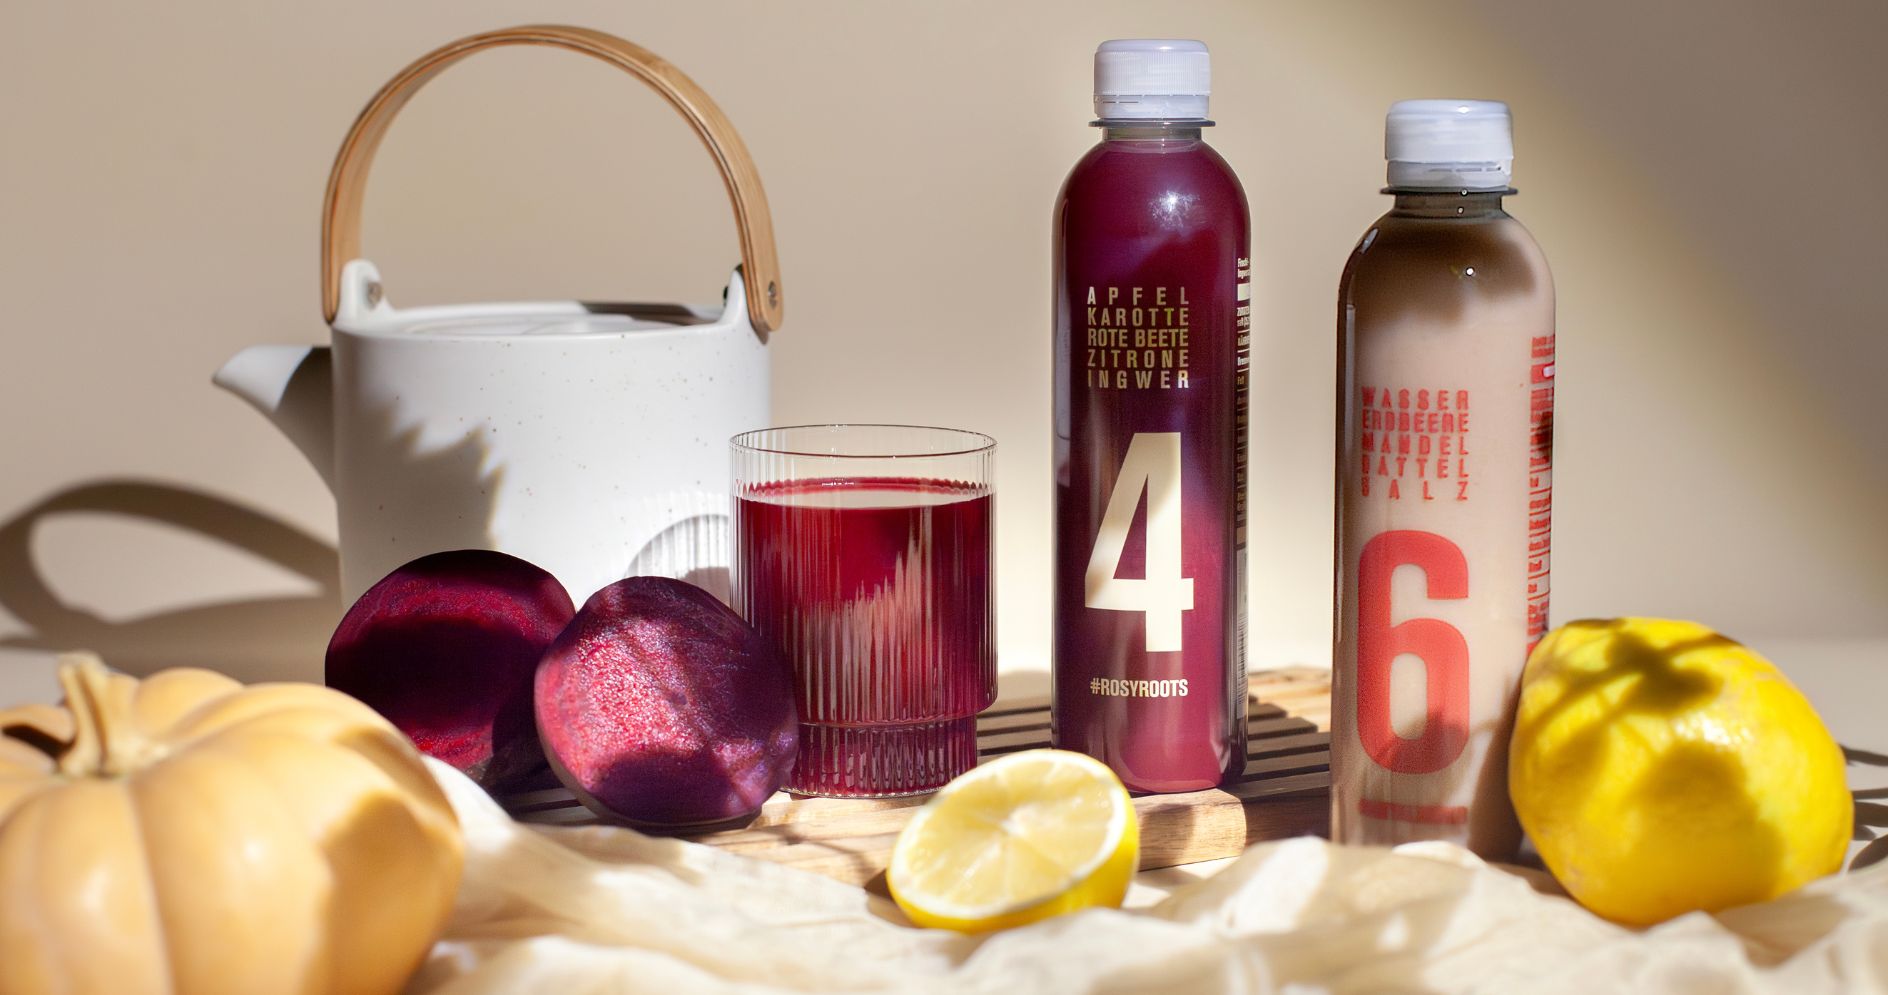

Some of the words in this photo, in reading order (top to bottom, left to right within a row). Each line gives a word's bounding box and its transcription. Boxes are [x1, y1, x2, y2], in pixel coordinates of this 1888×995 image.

[1087, 286, 1189, 305] APFEL
[1087, 307, 1189, 326] KAROTTE
[1087, 328, 1128, 347] ROTE
[1135, 328, 1189, 347] BEETE
[1087, 349, 1189, 368] ZITRONE
[1087, 370, 1189, 389] INGWER
[1361, 386, 1469, 410] WASSER
[1361, 409, 1469, 433] ERDBEERE
[1361, 432, 1469, 455] MANDEL
[1361, 476, 1469, 500] SALZ
[1085, 432, 1194, 652] 4
[1357, 529, 1470, 775] 6
[1089, 677, 1189, 698] #ROSYROOTS
